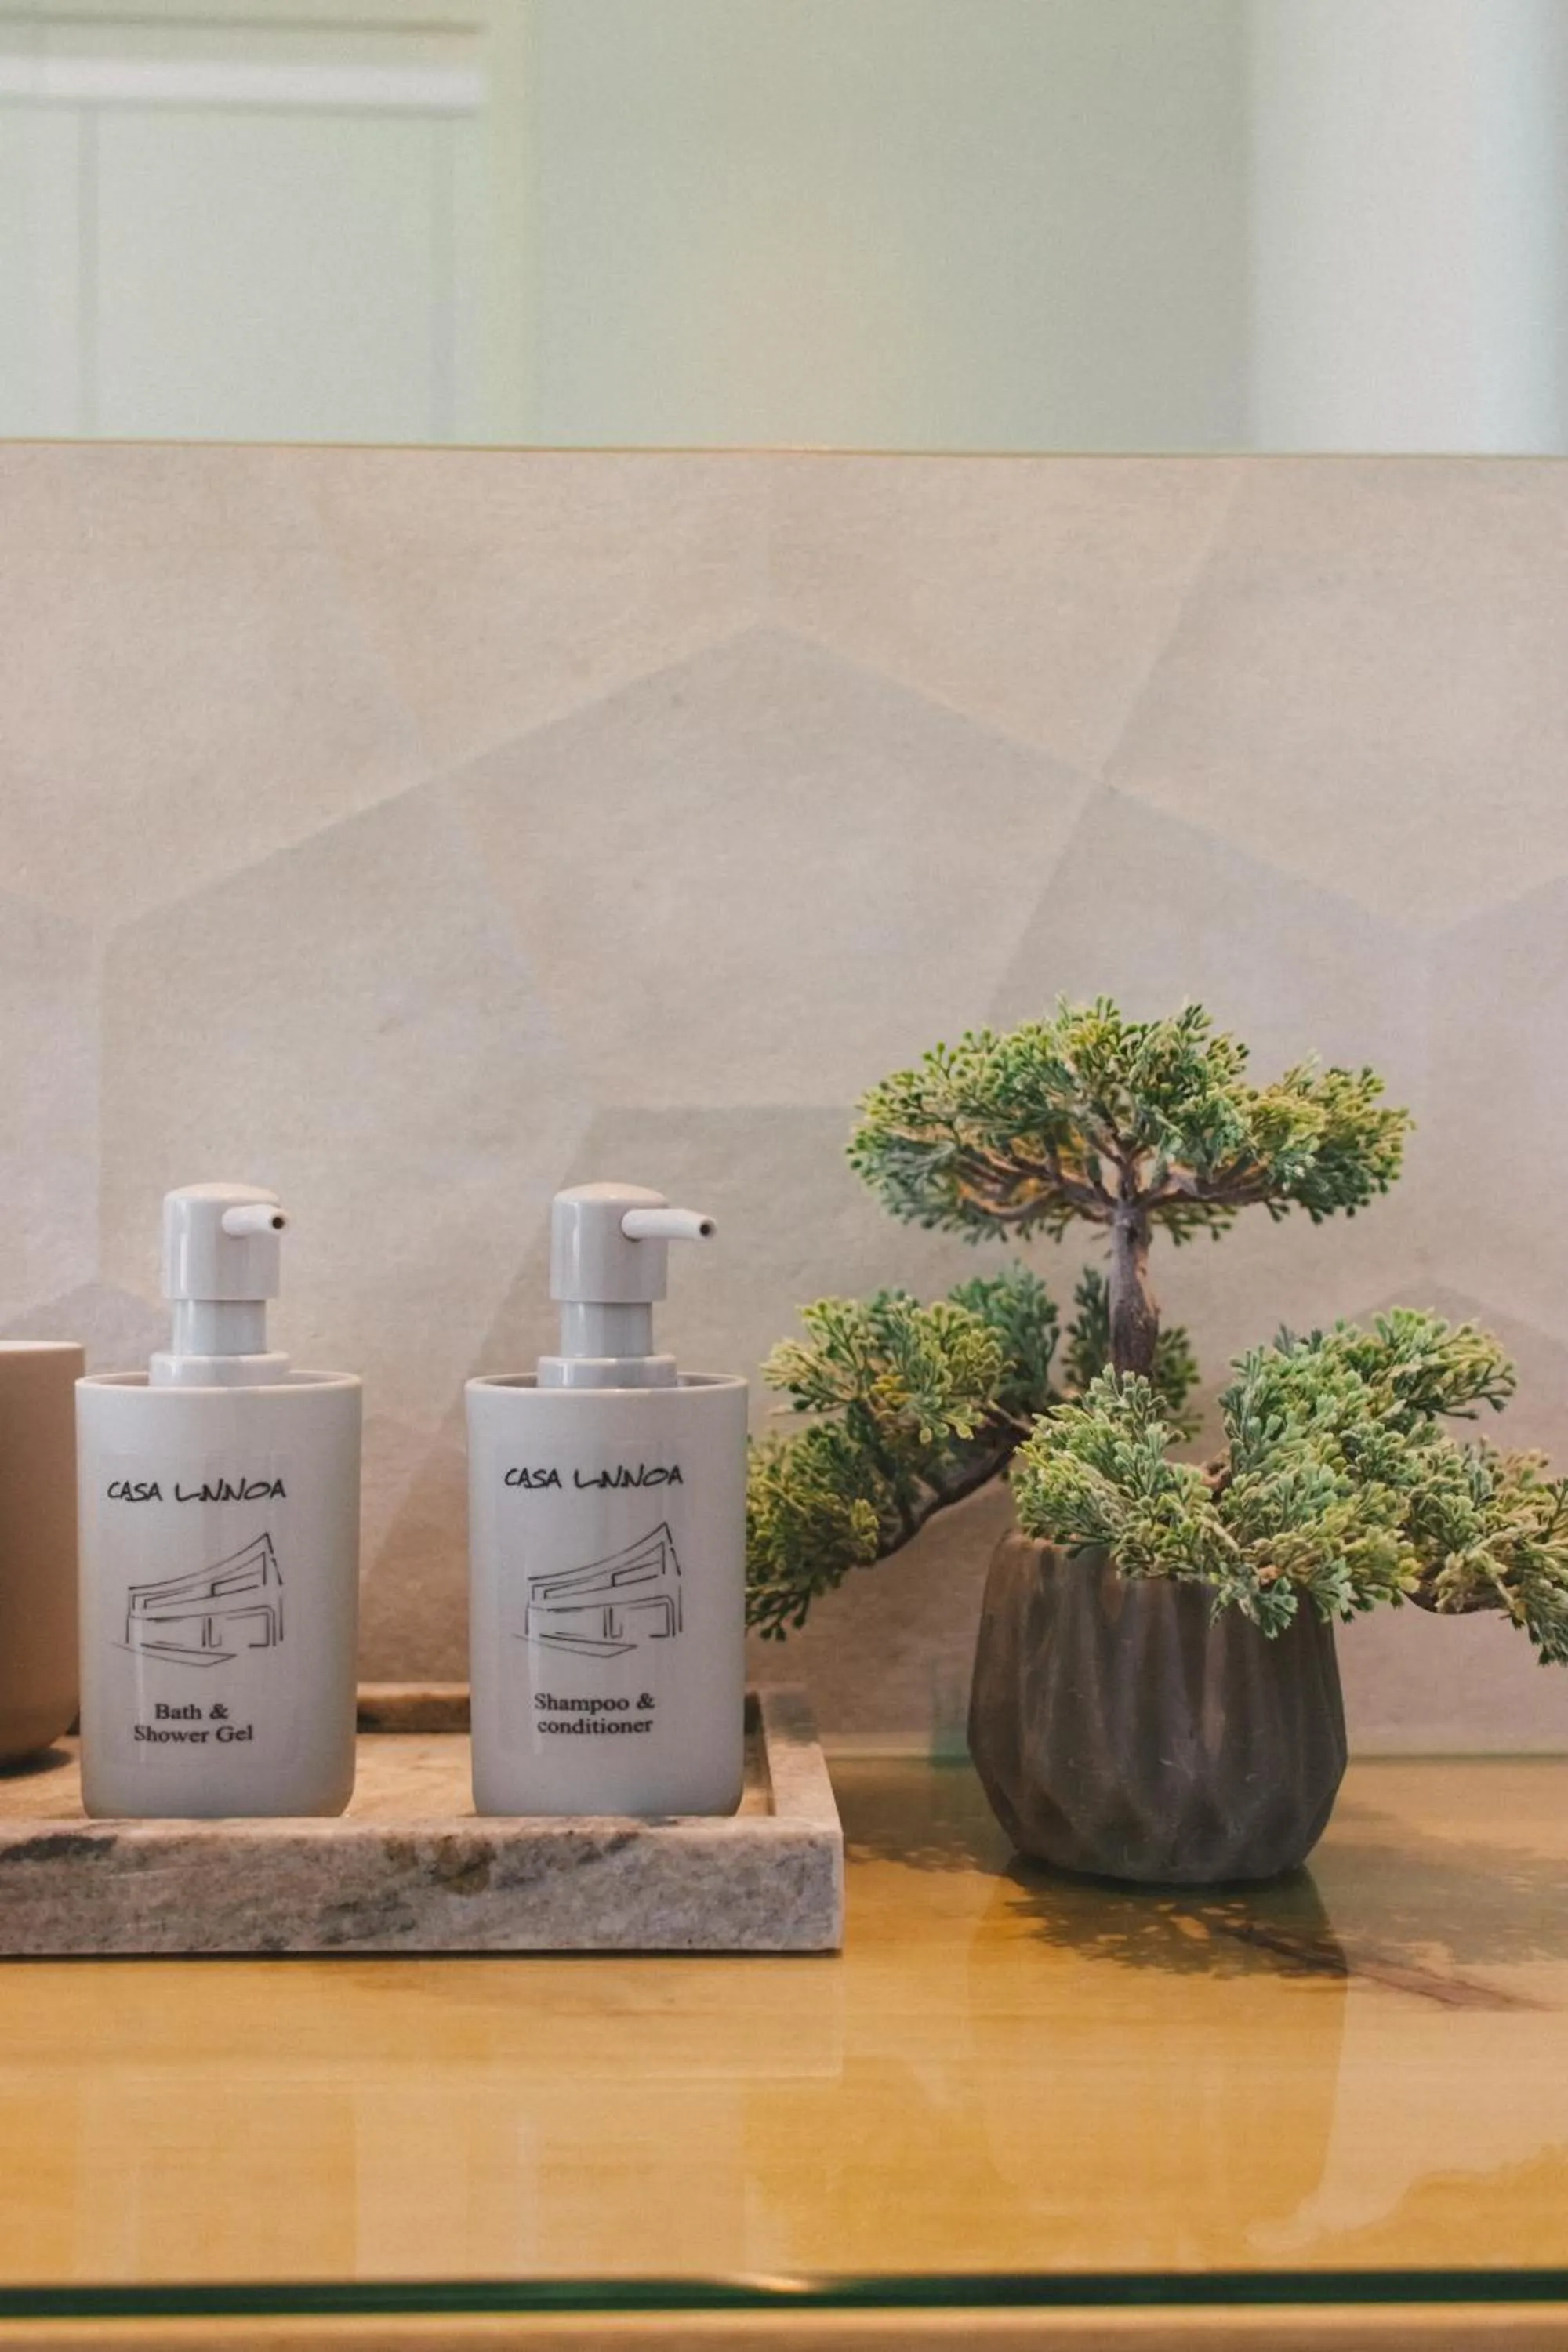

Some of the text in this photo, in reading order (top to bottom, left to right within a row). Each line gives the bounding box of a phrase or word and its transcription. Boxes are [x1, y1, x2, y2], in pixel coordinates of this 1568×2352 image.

[503, 1465, 563, 1489] CASA
[107, 1479, 163, 1501] CASA
[154, 1703, 229, 1720] Bath &
[534, 1693, 655, 1714] Shampoo &
[133, 1724, 253, 1743] Shower Gel
[537, 1718, 654, 1735] conditioner
